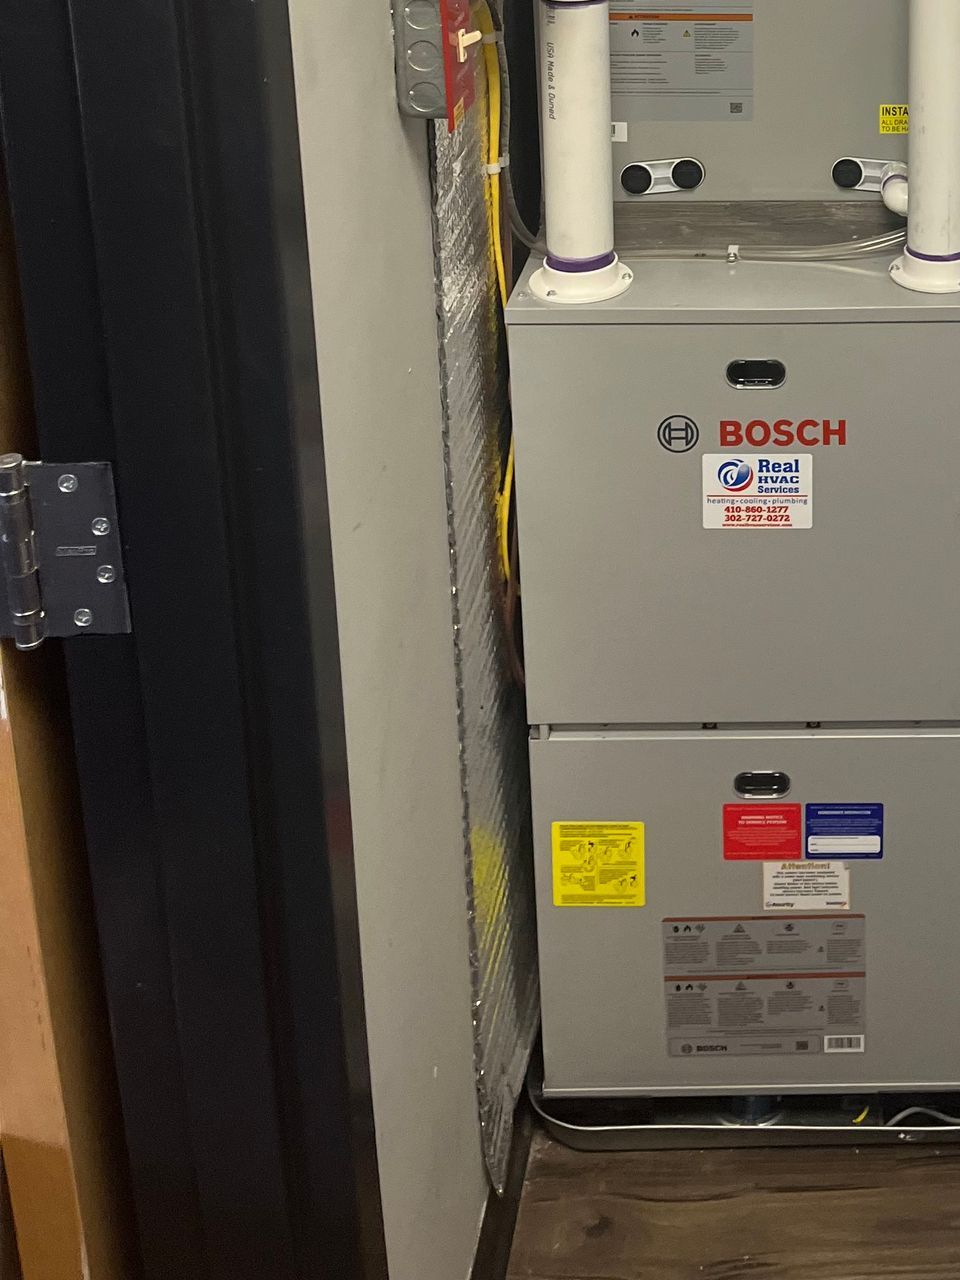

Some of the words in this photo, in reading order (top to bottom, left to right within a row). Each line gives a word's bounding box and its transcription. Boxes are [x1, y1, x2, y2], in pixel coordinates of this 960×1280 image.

[720, 419, 847, 447] BOSCH
[757, 459, 800, 473] Real
[757, 475, 800, 484] HVAC
[757, 485, 800, 494] Services
[724, 506, 789, 514] 410-860-1277
[724, 514, 791, 522] 302-727-0272
